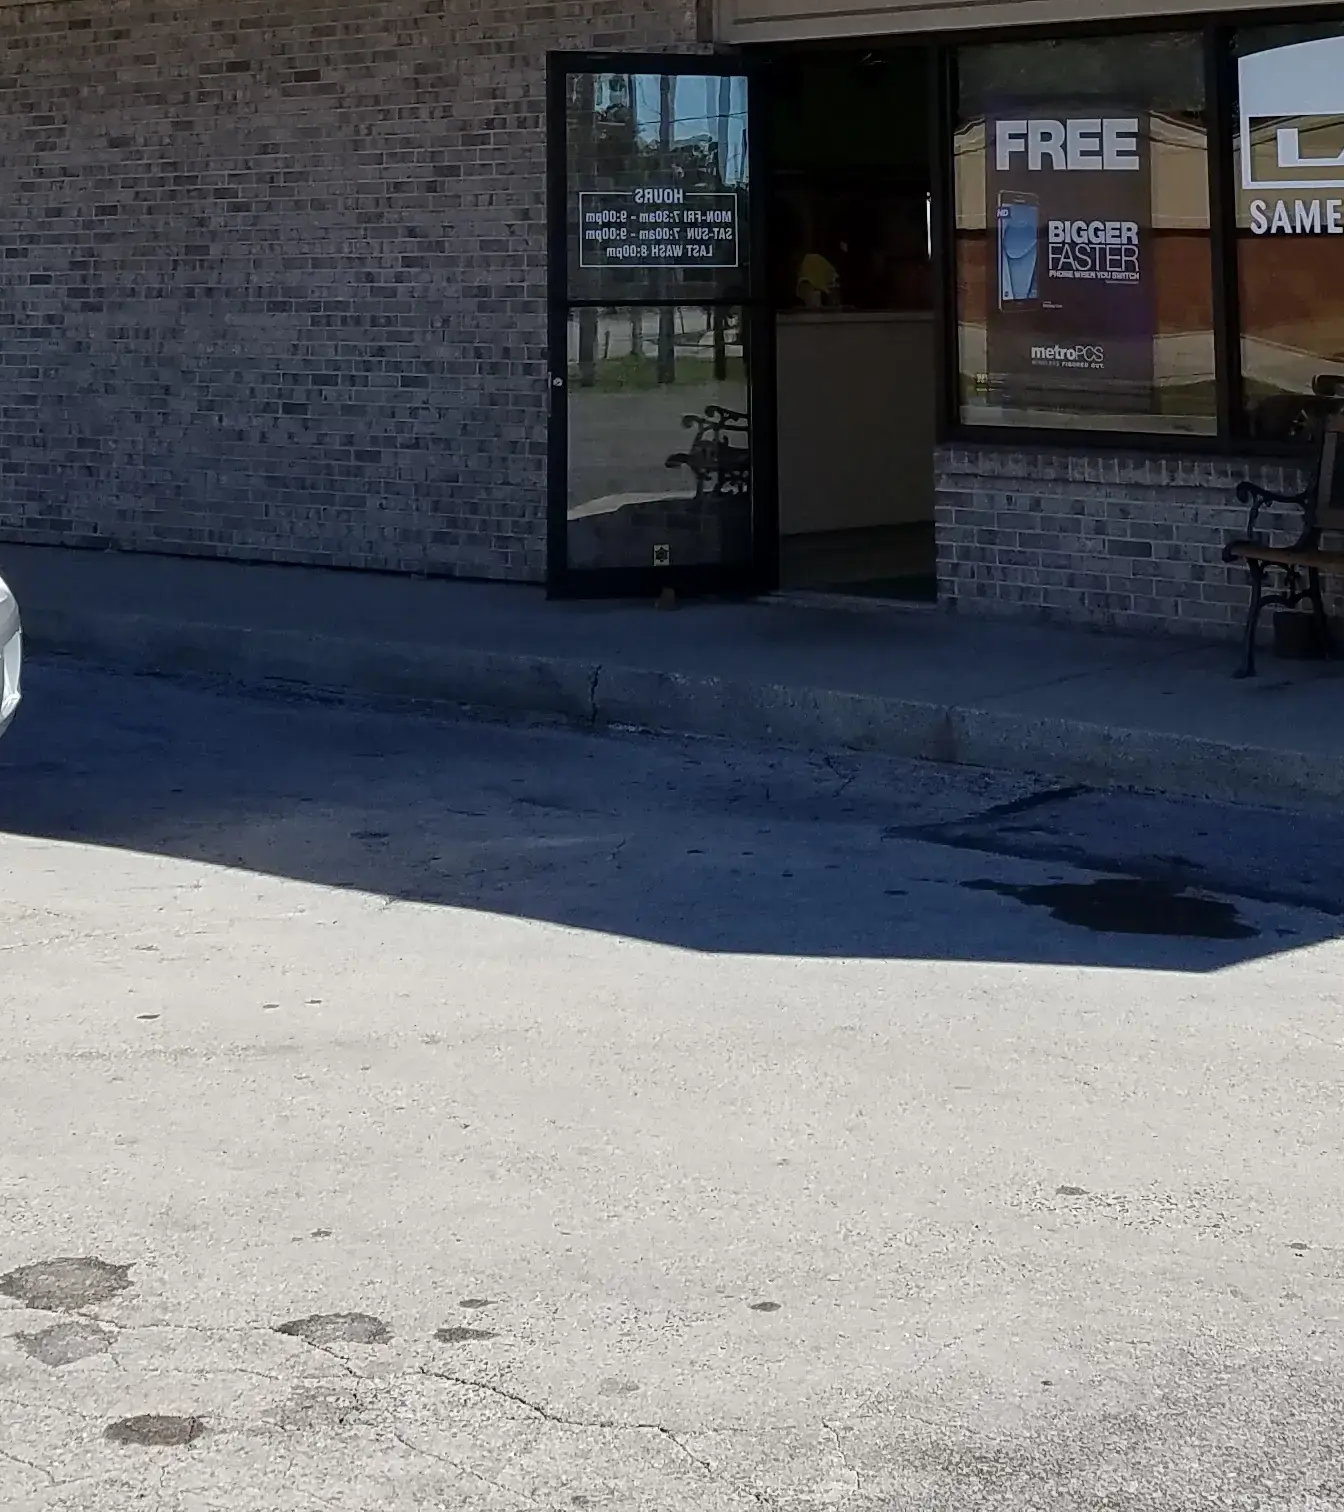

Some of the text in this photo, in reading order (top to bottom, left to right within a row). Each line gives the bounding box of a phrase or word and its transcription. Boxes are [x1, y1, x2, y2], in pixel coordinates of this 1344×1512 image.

[995, 118, 1140, 171] FREE
[1248, 198, 1344, 235] SAME
[1048, 220, 1139, 245] BIGGER
[1048, 243, 1140, 272] FASTER
[1096, 271, 1112, 279] YOU
[1031, 344, 1104, 362] metroPCS
